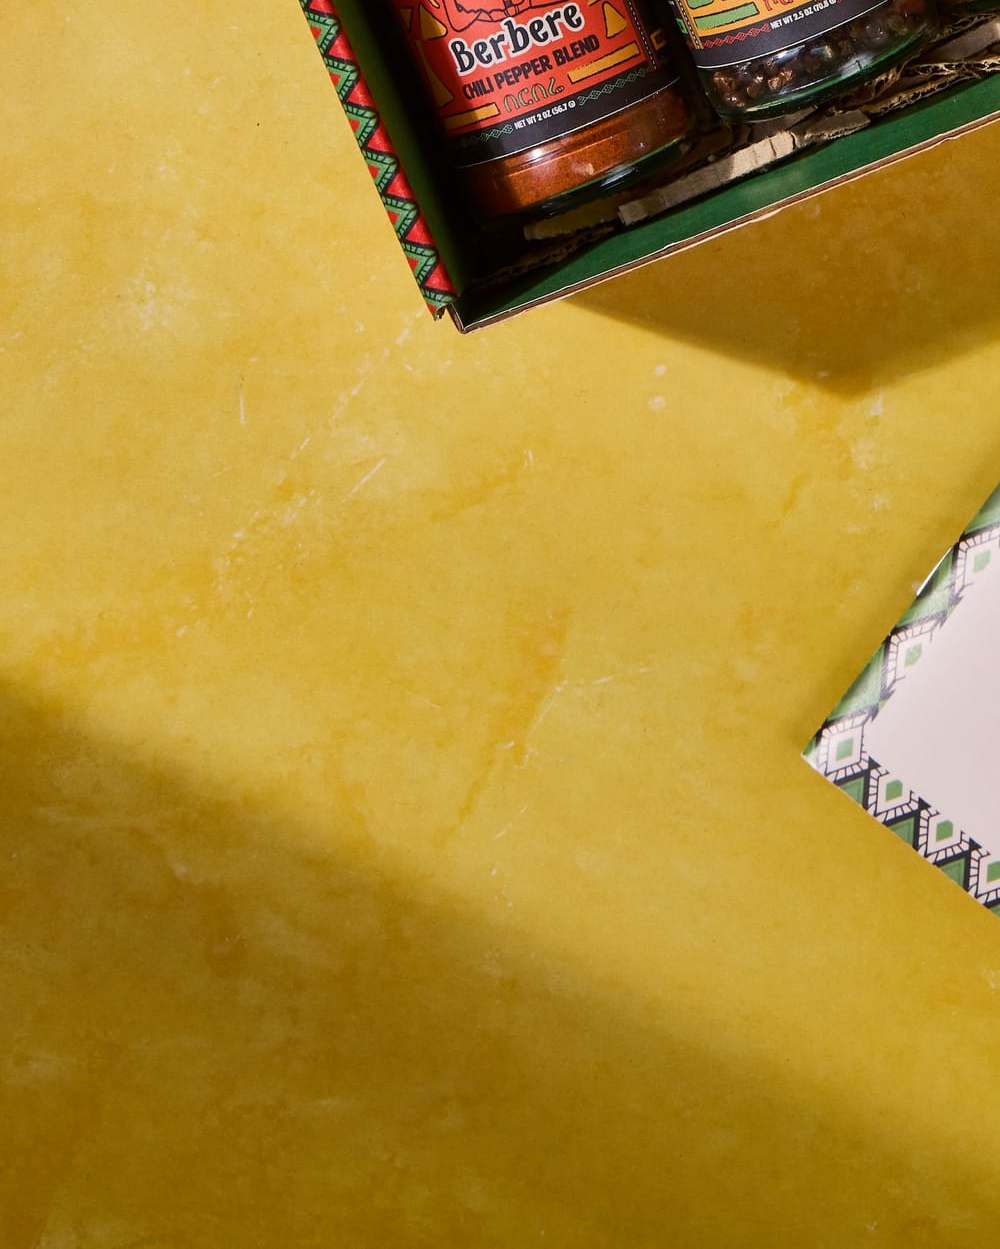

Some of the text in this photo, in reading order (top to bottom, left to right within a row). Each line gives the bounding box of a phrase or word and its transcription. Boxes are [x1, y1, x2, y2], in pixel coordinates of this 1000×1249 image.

[450, 4, 583, 72] Berbere
[770, 19, 784, 30] NET
[782, 14, 794, 25] WT
[804, 7, 814, 17] OZ
[462, 34, 600, 100] CHILI PEPPER BLEND
[514, 118, 527, 130] NET
[525, 114, 538, 126] WT
[536, 111, 543, 122] 2
[542, 108, 552, 120] OZ
